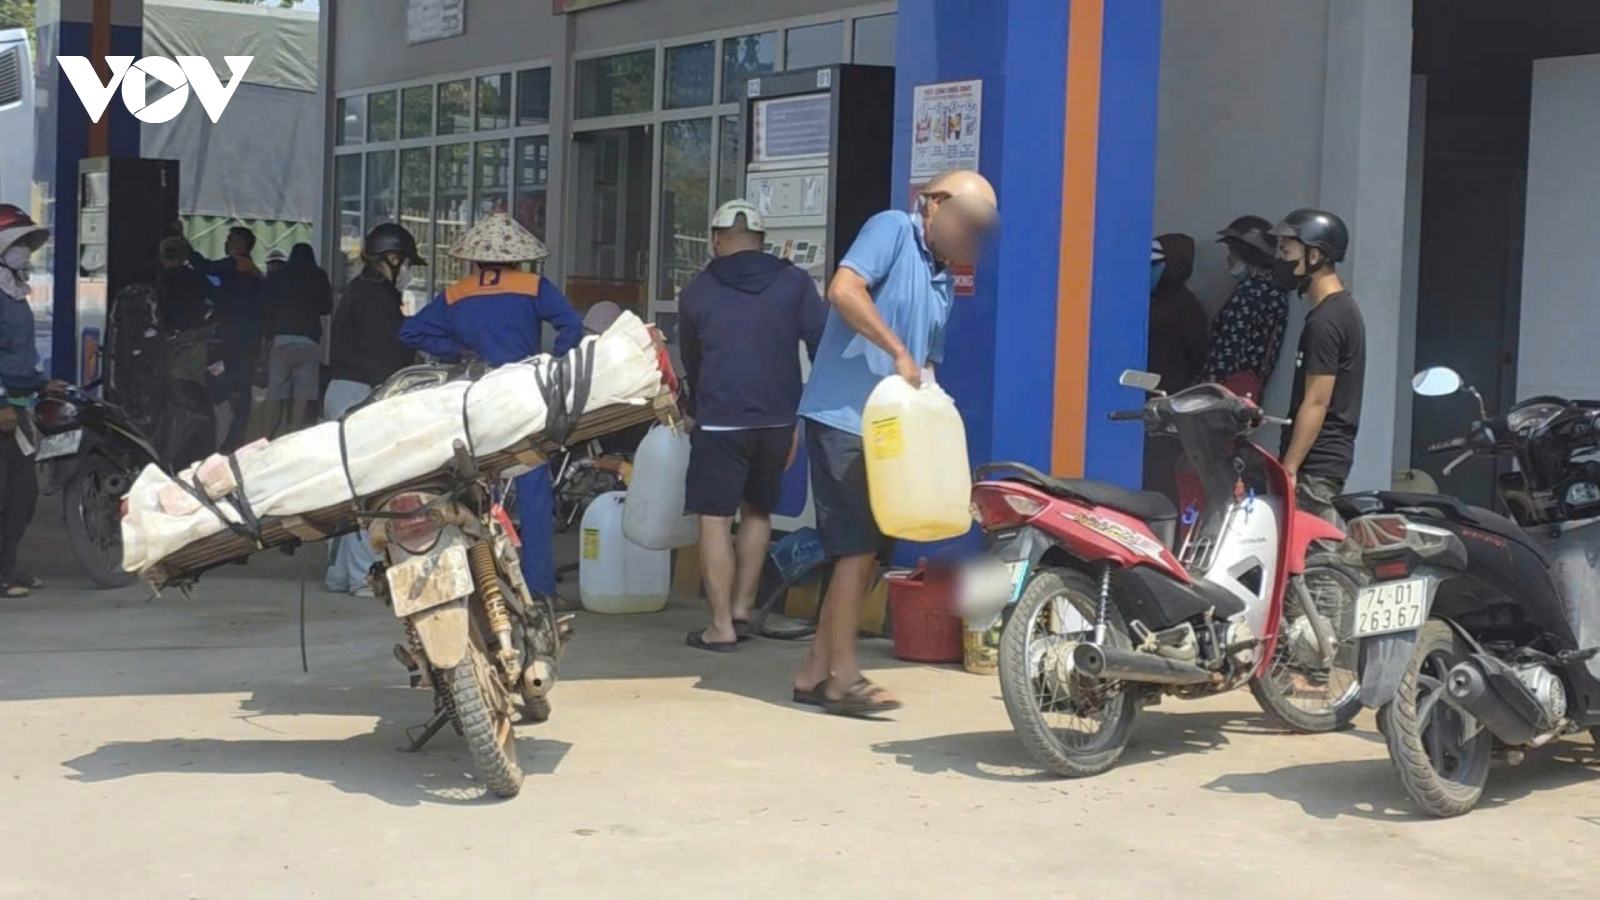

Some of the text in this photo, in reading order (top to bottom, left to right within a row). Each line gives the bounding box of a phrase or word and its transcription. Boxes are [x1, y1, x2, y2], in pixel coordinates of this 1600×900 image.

[819, 71, 830, 86] 01
[749, 80, 760, 95] 02
[1359, 605, 1419, 632] 263.67
